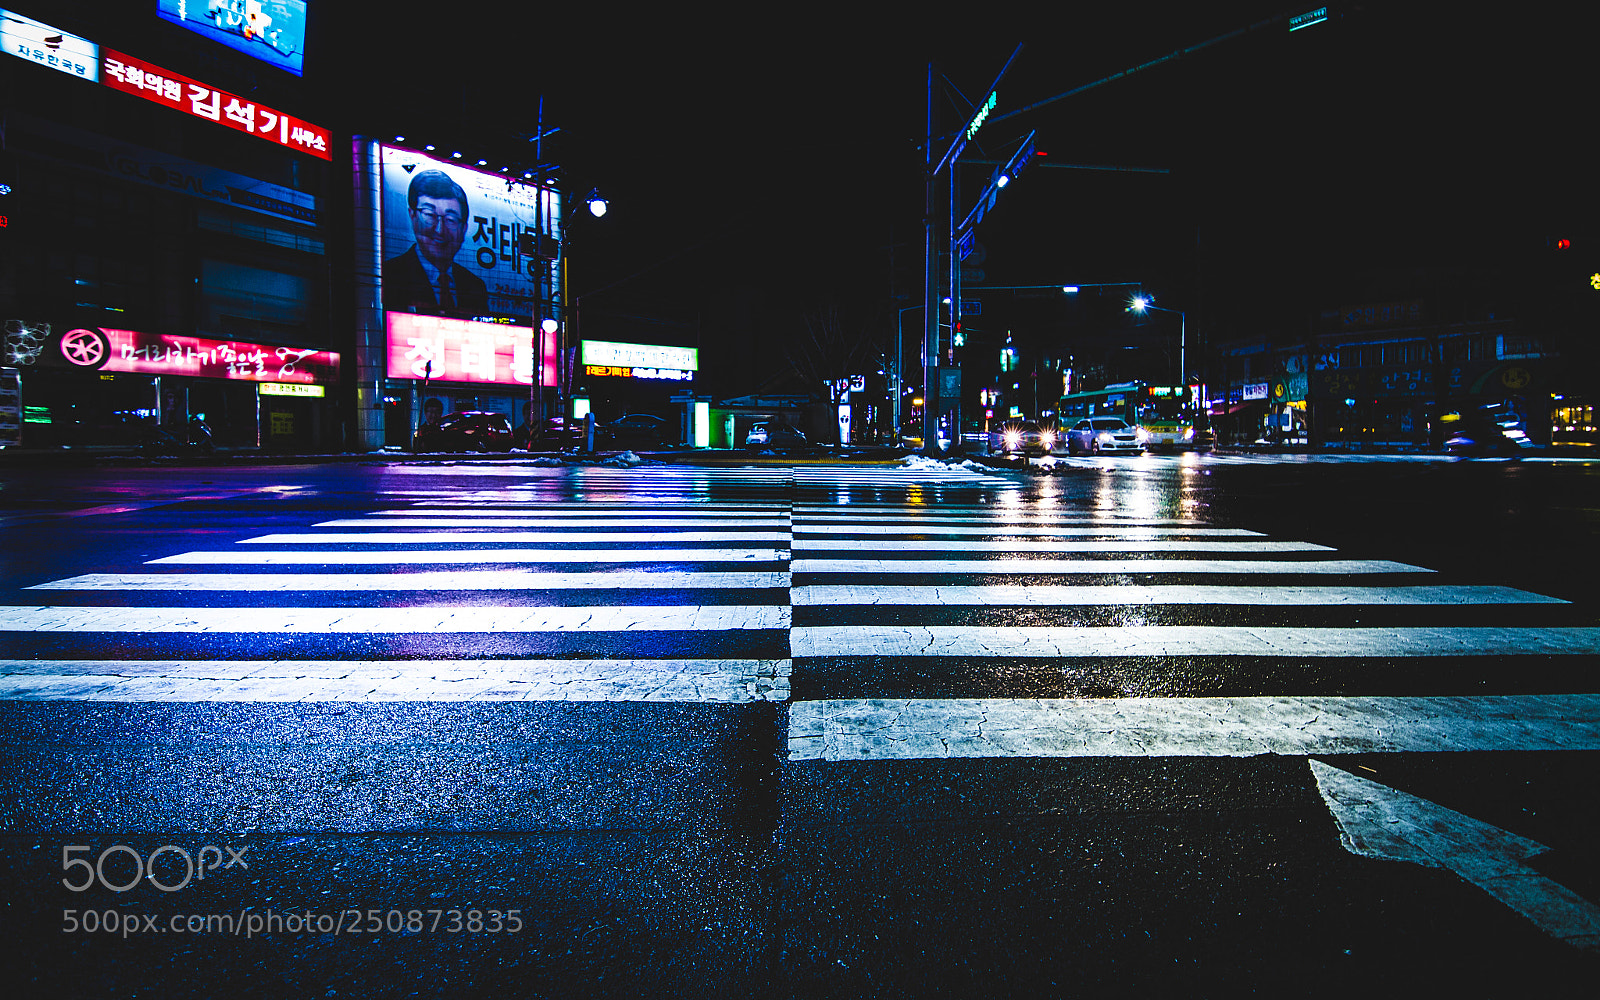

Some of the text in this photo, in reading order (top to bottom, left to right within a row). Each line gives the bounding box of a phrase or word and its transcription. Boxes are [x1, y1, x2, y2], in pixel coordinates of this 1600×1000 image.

[17, 43, 87, 76] 자유한국당
[104, 57, 327, 152] 국회의원 김석기 사무소
[472, 215, 548, 284] 정태
